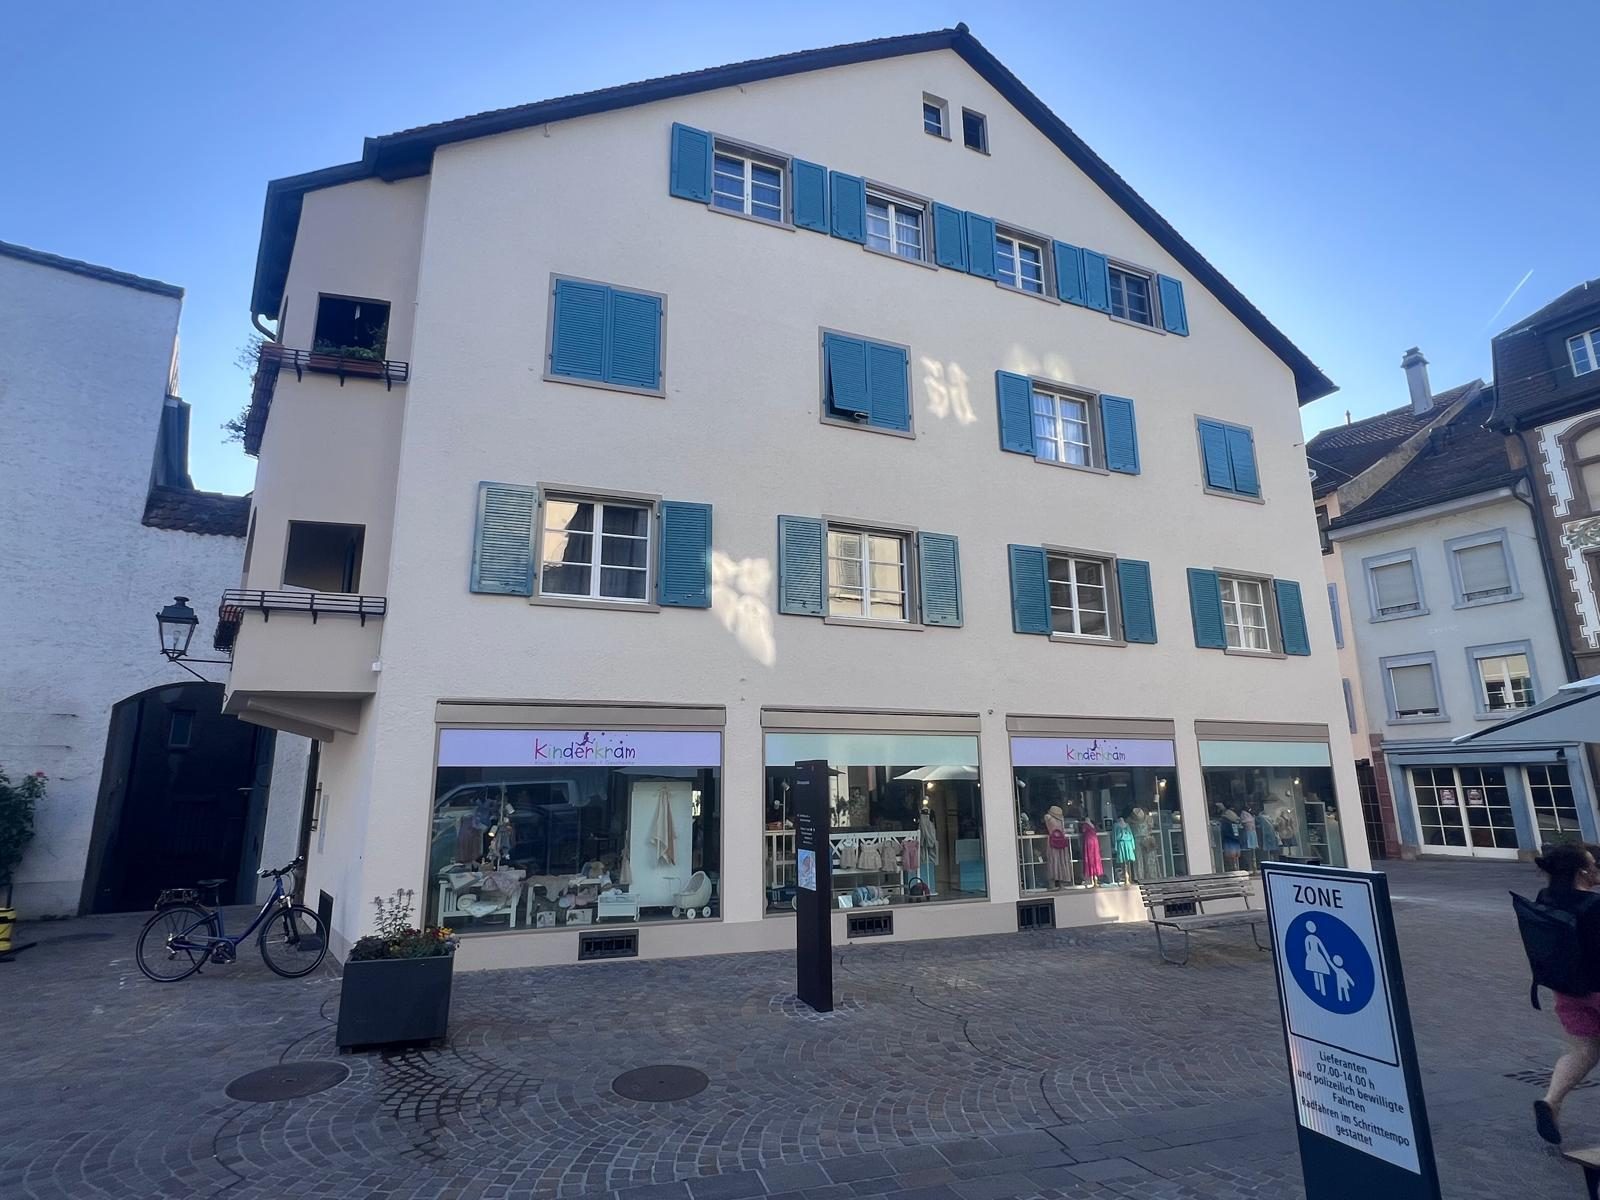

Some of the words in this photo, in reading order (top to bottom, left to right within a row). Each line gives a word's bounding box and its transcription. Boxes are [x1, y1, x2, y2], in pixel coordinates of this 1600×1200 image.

[1293, 884, 1343, 909] ZONE
[1319, 1051, 1367, 1074] Lieferanten
[1298, 1070, 1312, 1080] und
[1313, 1074, 1355, 1096] polizeilich
[1357, 1088, 1404, 1113] bewilligte
[1369, 1078, 1375, 1090] h
[1332, 1093, 1366, 1113] Fahrten
[1301, 1095, 1340, 1119] Radfahren
[1341, 1111, 1351, 1124] im
[1353, 1116, 1410, 1147] Schritttempo
[1336, 1126, 1373, 1146] gestattet
